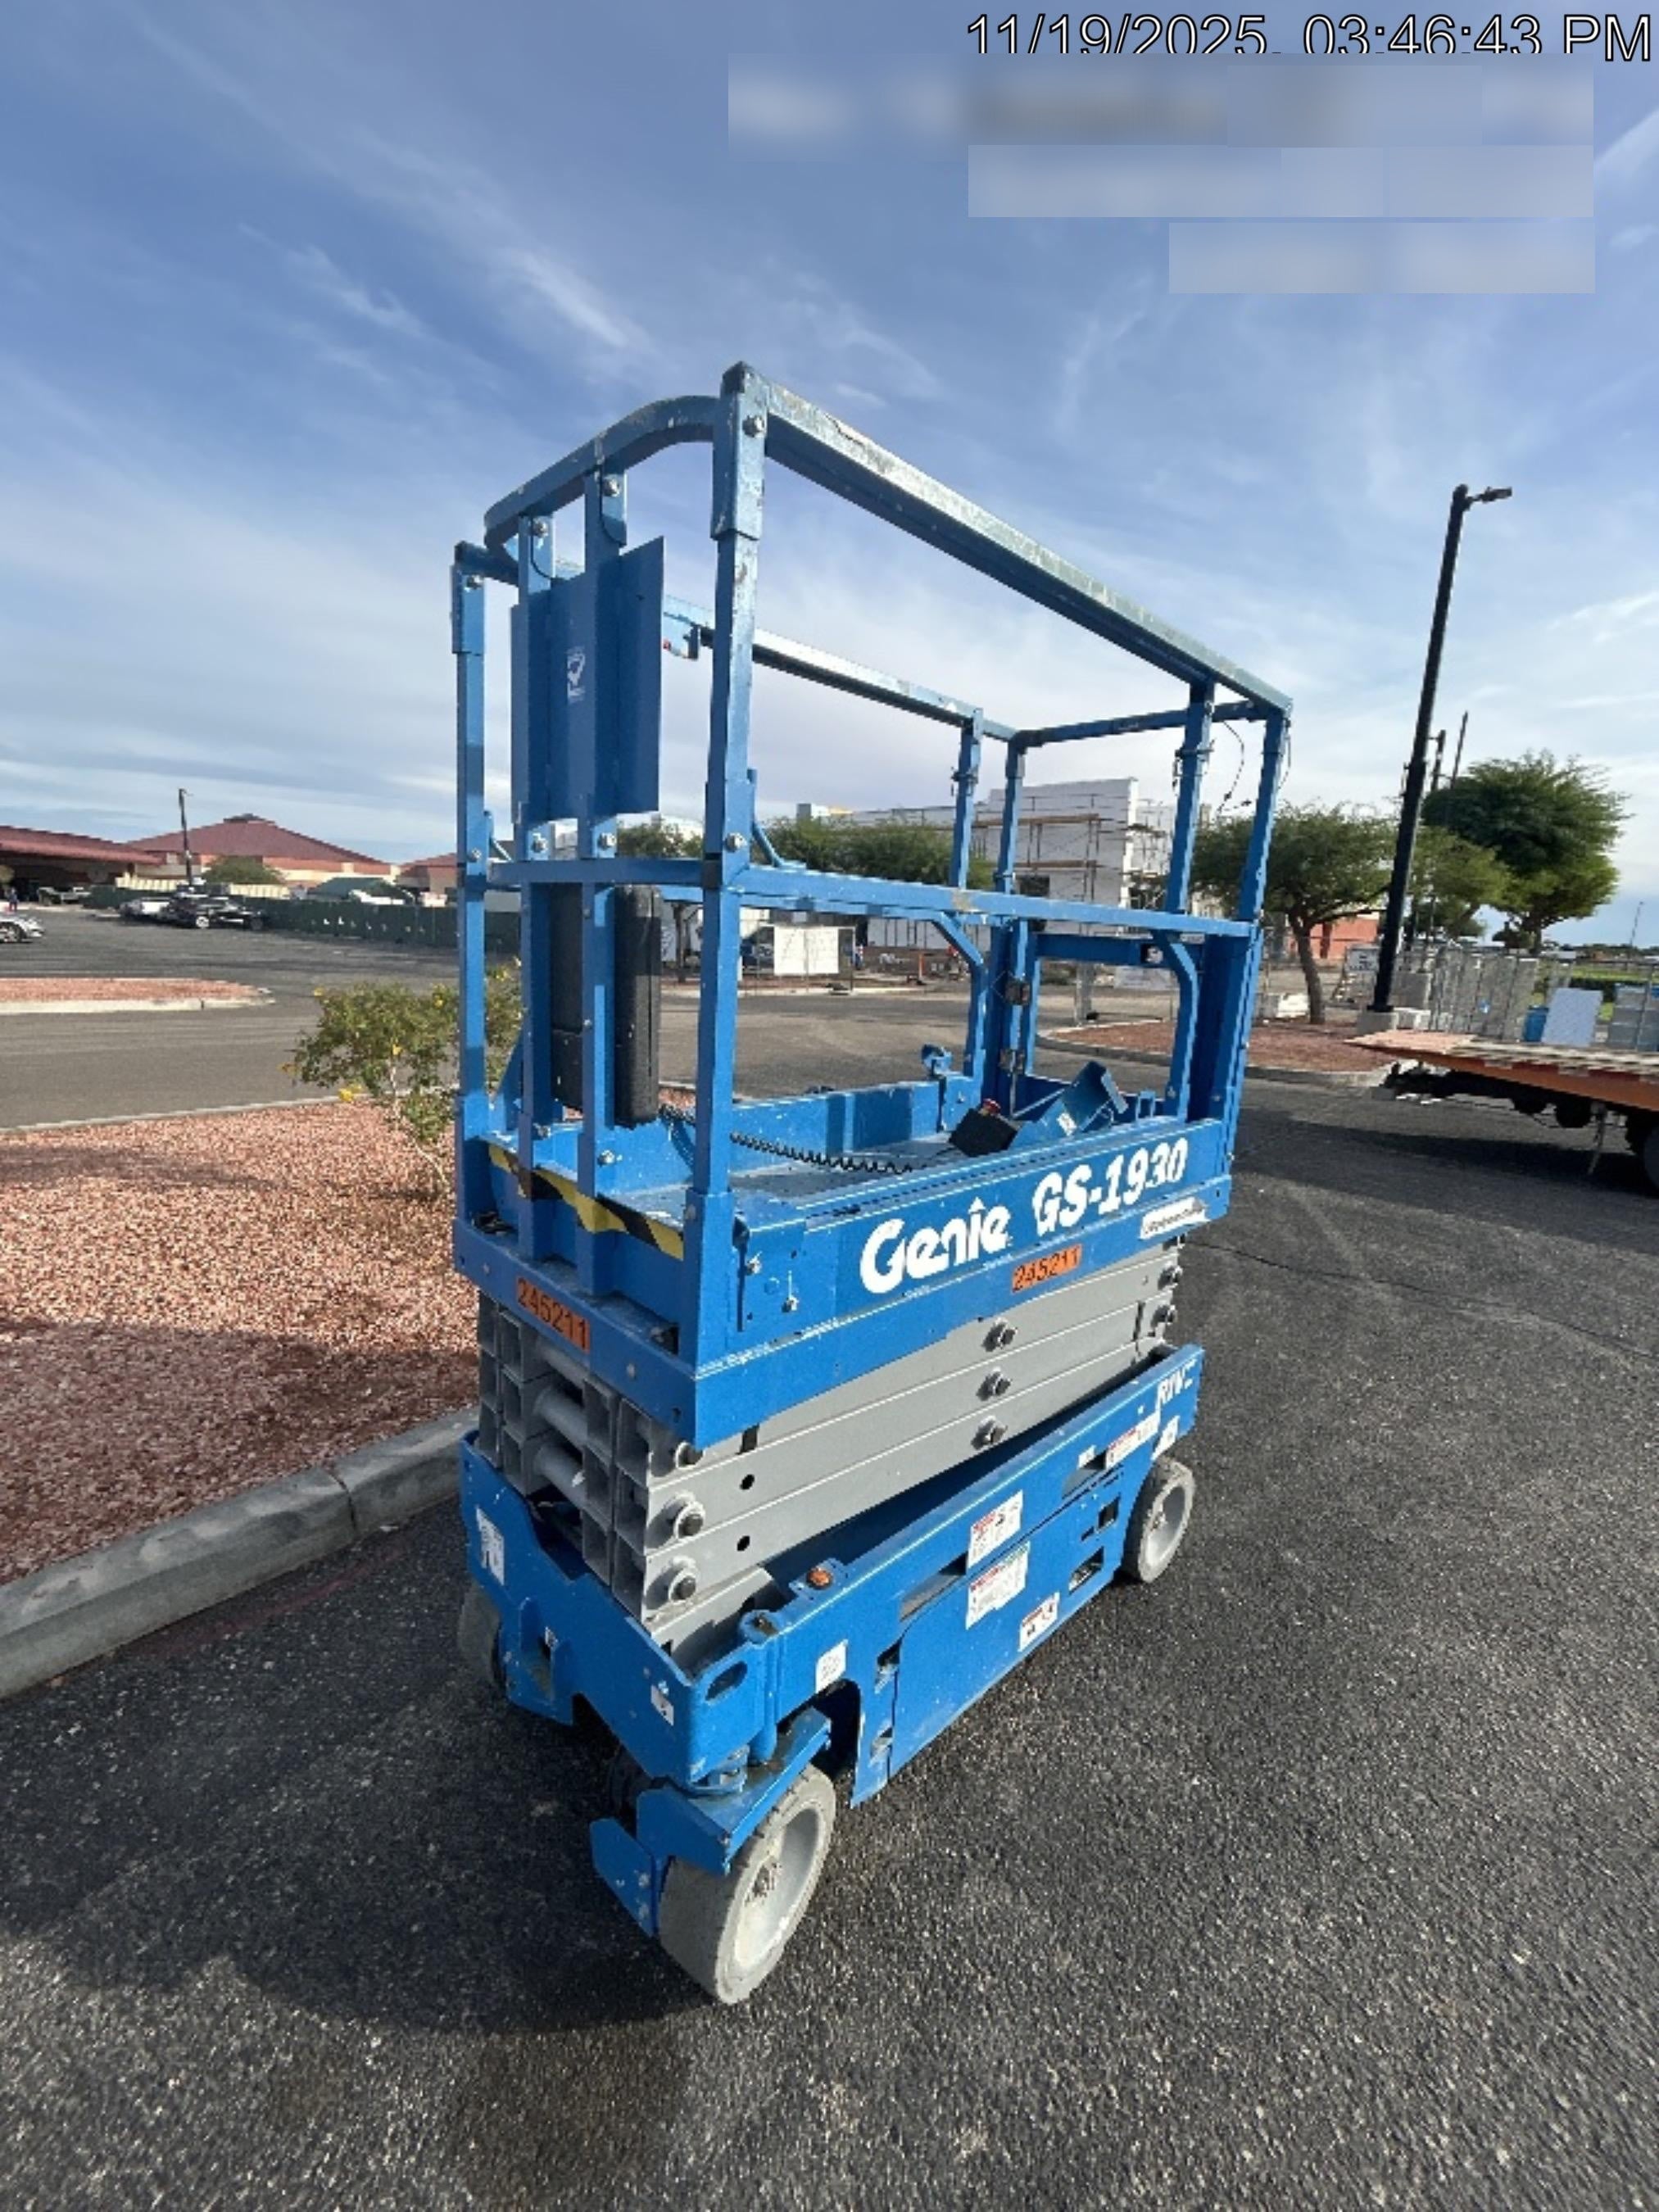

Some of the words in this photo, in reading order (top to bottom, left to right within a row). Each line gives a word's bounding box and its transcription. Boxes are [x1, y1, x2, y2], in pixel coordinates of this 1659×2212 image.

[859, 1196, 1012, 1294] Genie
[1031, 1137, 1189, 1237] GS-1930
[1013, 1245, 1081, 1292] 245211
[518, 1277, 586, 1351] 245211
